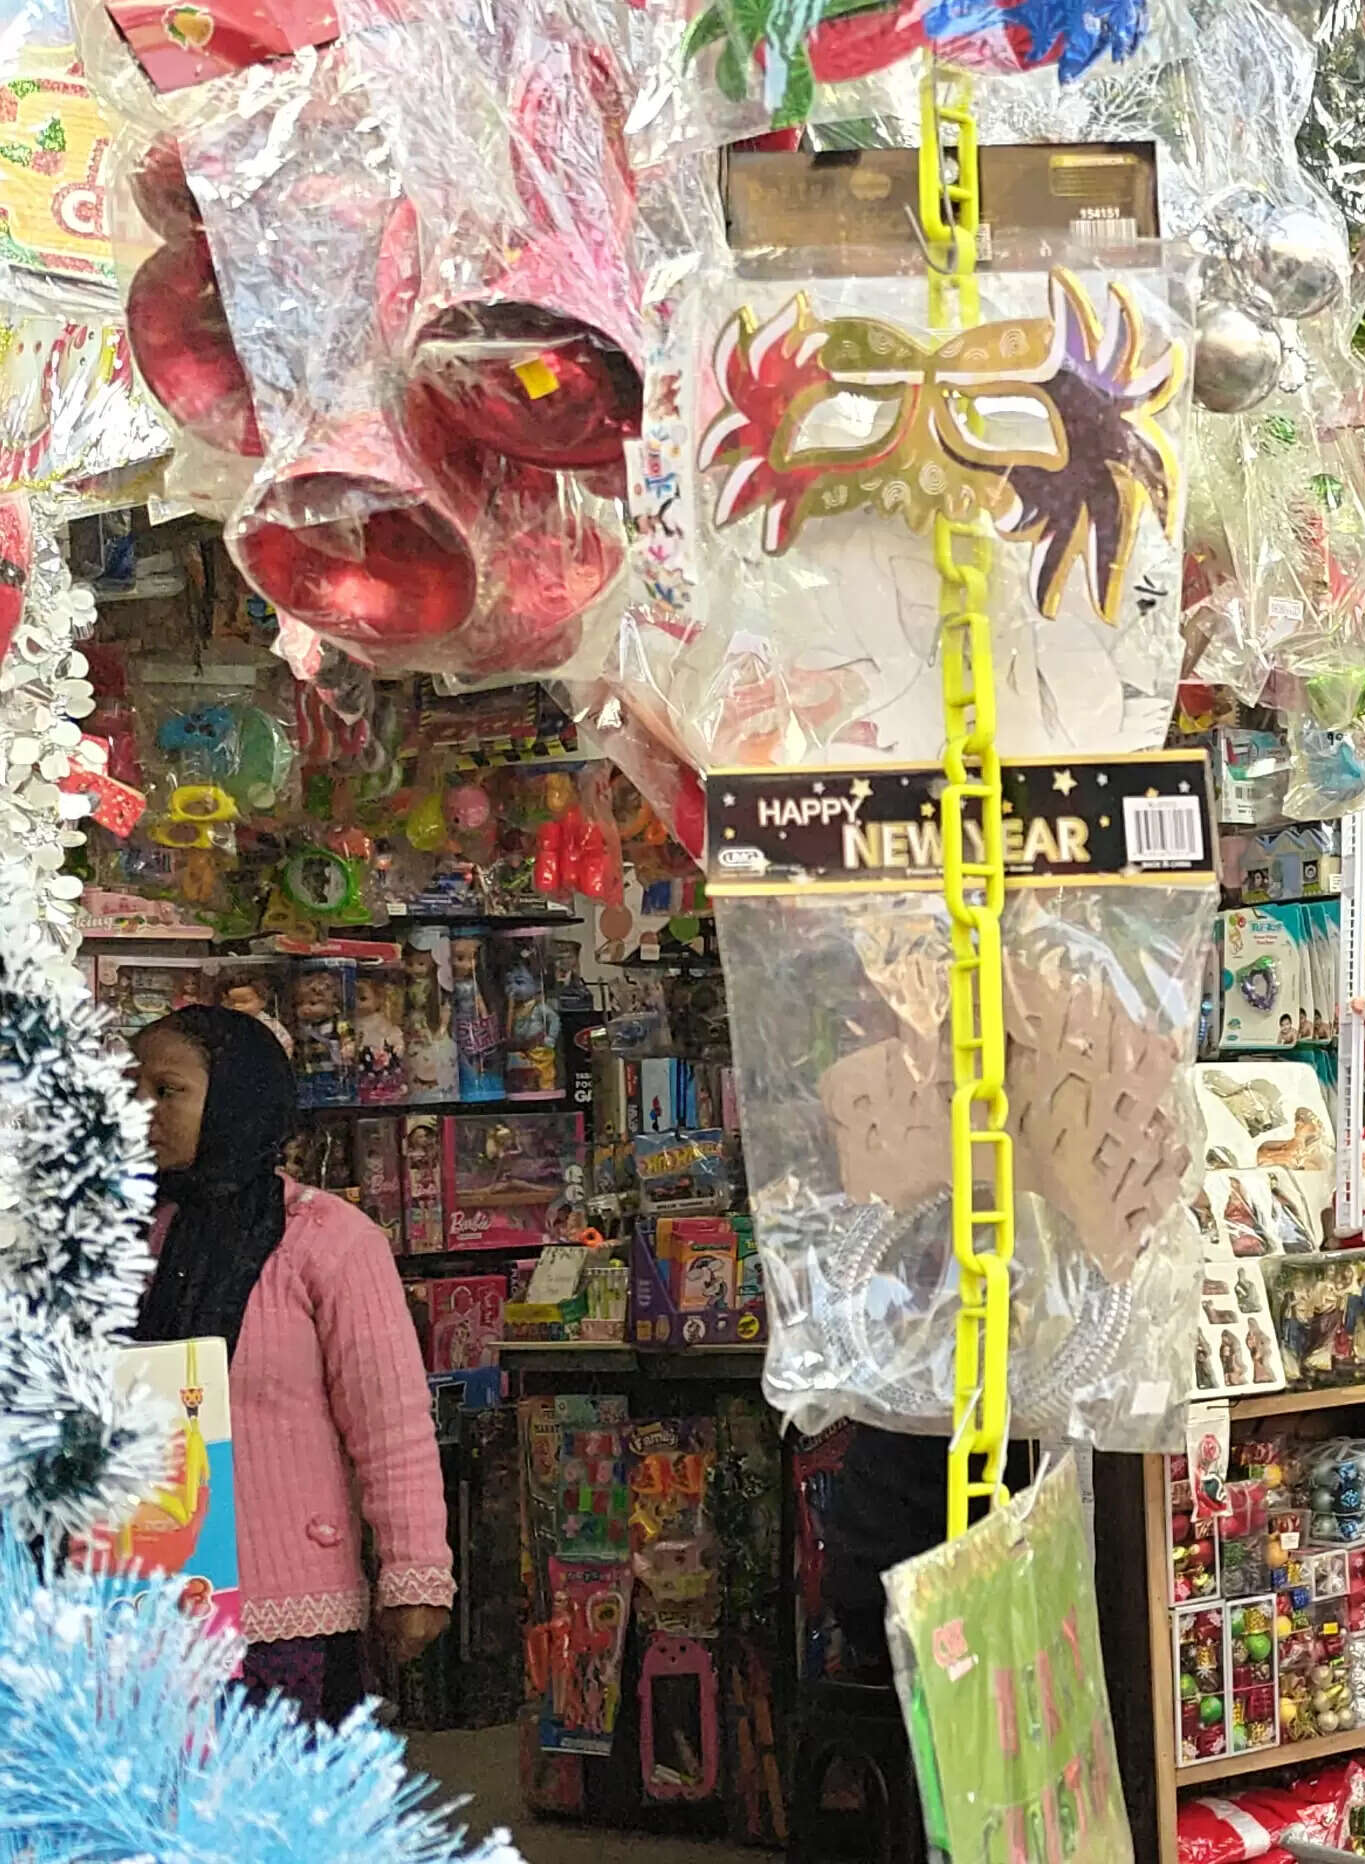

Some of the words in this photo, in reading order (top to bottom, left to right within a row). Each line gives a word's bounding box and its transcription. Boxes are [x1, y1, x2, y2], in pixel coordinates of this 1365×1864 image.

[758, 797, 862, 828] HAPPY
[841, 822, 948, 869] NEW
[963, 816, 1092, 866] YEAR
[451, 1211, 491, 1234] Barbie
